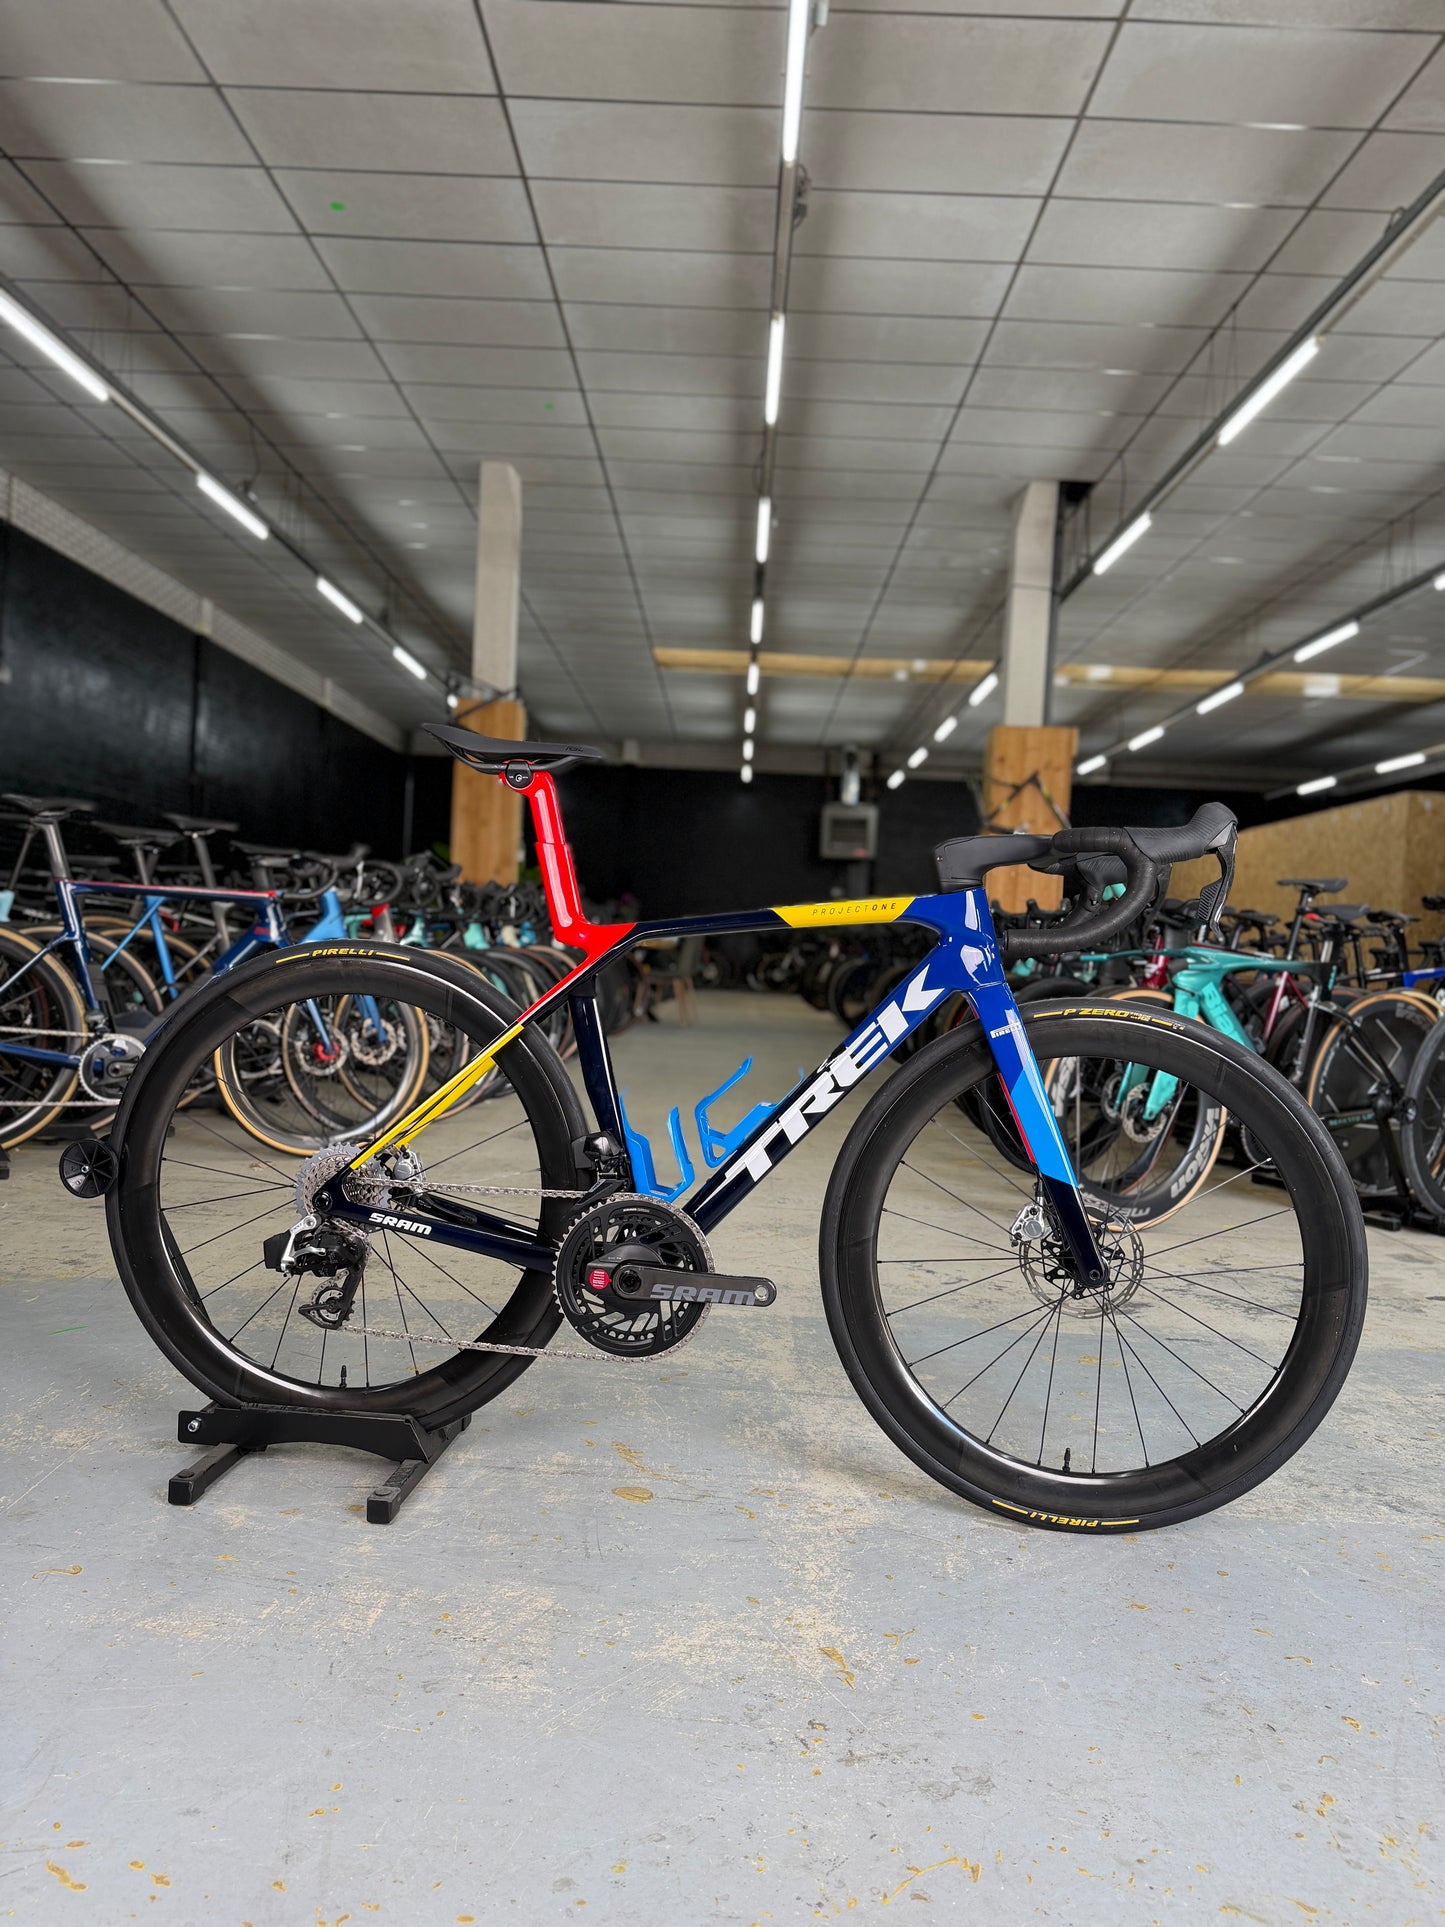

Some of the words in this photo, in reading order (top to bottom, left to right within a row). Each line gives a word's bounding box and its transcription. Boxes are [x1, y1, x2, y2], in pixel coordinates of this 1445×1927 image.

[312, 948, 374, 957] PIRELLI
[1063, 1008, 1077, 1016] P
[1079, 1008, 1129, 1018] ZERO
[724, 963, 945, 1183] TREK
[368, 1212, 433, 1236] SRAM
[649, 1283, 757, 1306] SRAM
[1030, 1511, 1099, 1527] PIRELLI
